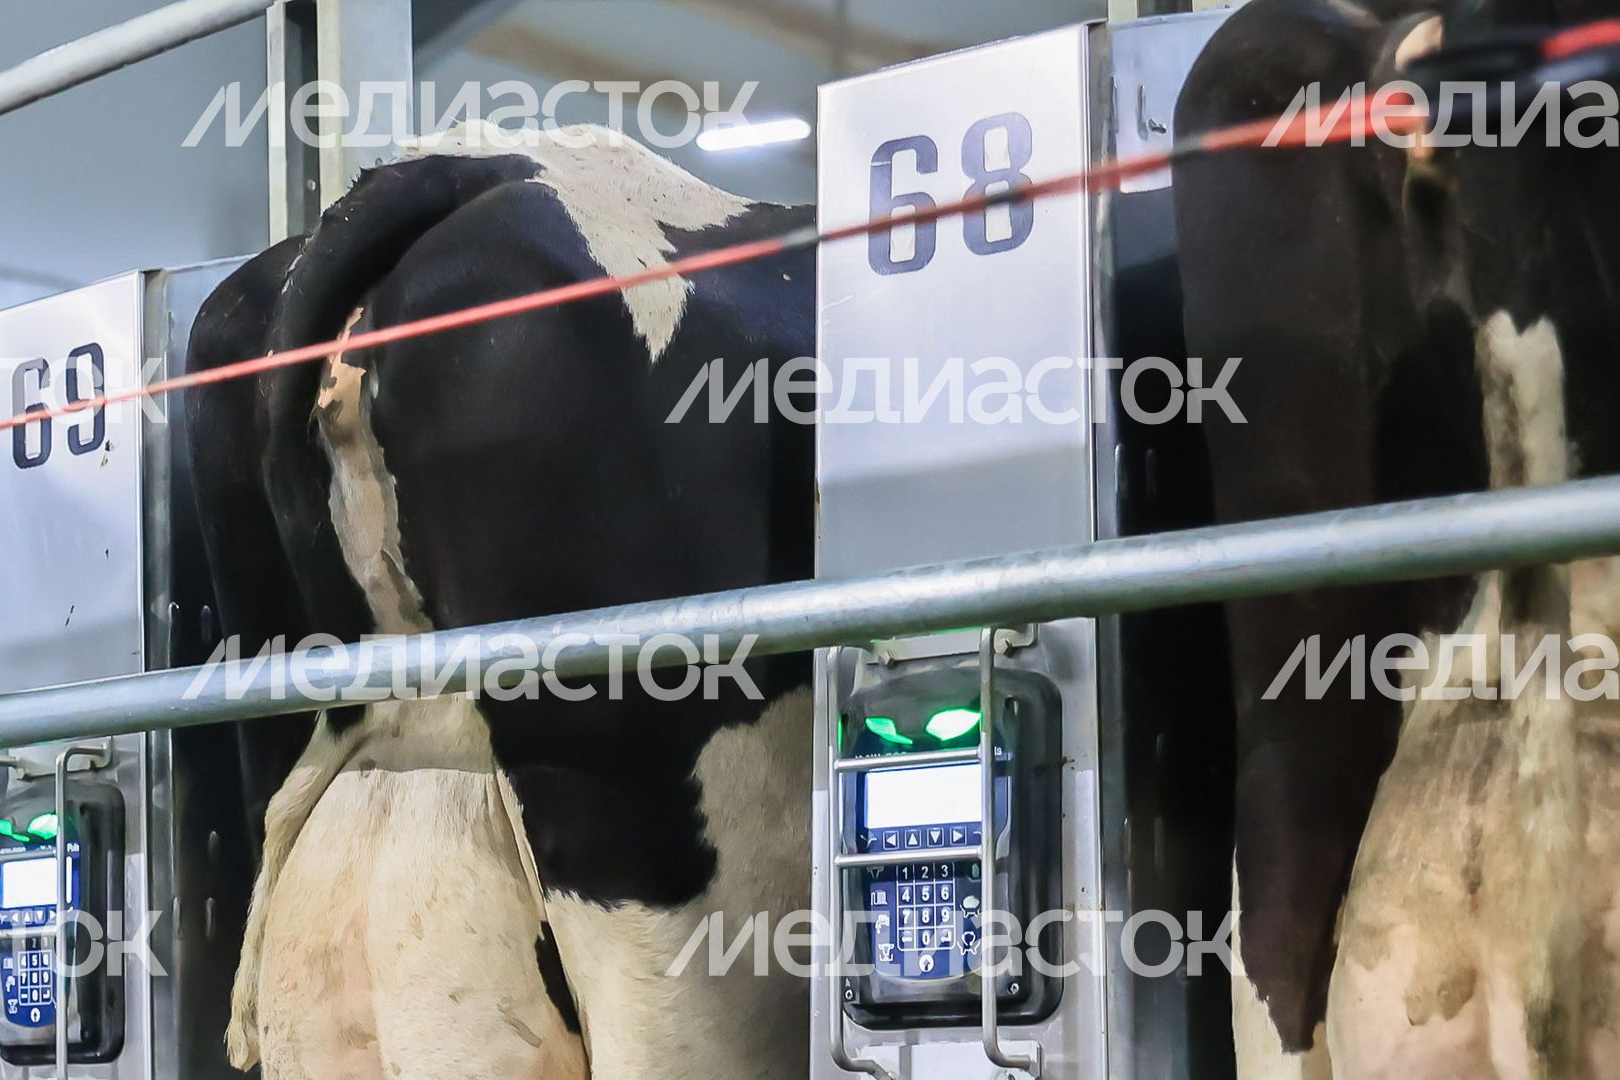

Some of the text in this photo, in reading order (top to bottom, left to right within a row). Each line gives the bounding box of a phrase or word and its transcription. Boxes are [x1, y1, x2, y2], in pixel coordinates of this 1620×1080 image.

[867, 112, 1034, 276] 68
[12, 342, 106, 470] 69
[902, 865, 949, 879] 1 2 3
[901, 886, 950, 902] 4 5 6
[902, 908, 950, 924] 7 8 9
[922, 931, 930, 946] 0
[31, 954, 38, 967] 5
[20, 973, 27, 985] 7
